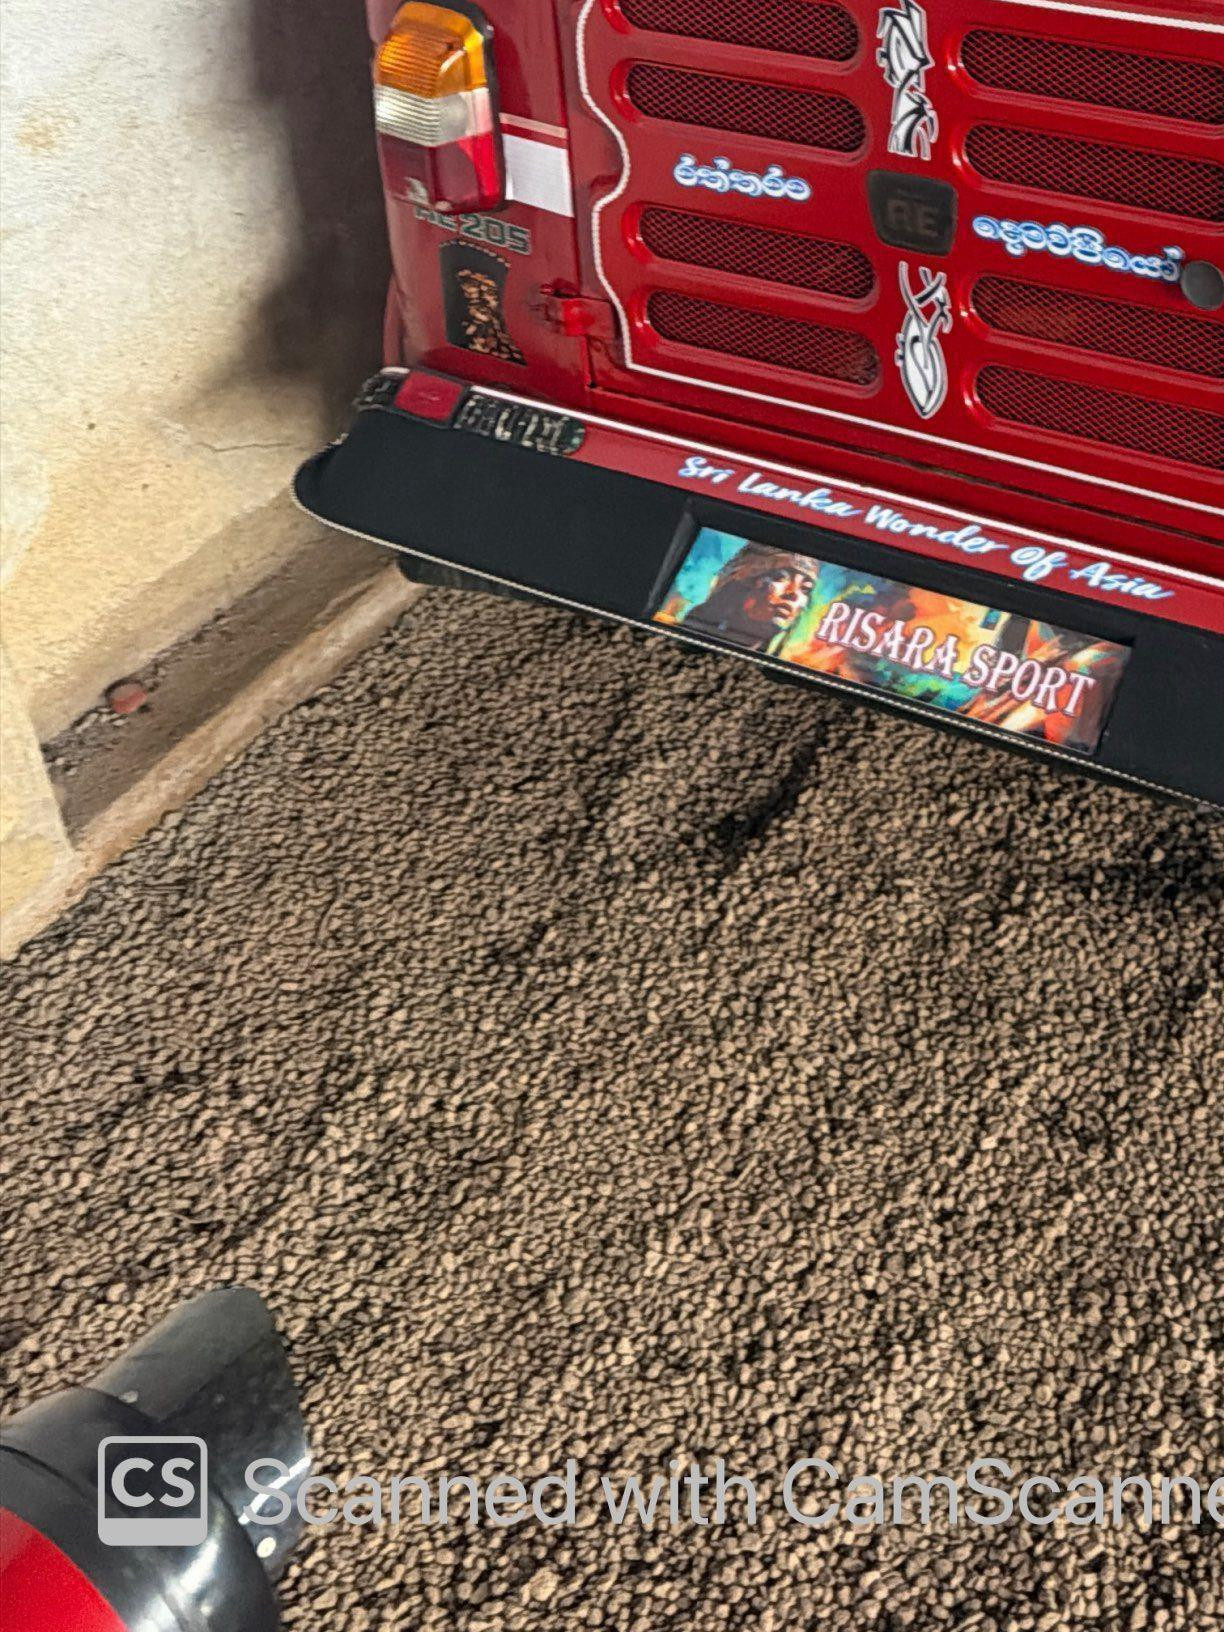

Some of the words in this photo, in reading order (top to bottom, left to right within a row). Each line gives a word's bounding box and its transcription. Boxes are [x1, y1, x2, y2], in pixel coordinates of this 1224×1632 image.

[677, 455, 735, 490] Sri
[738, 470, 863, 520] Lanka
[866, 503, 1008, 556] Wonder
[1010, 546, 1068, 582] Of
[1069, 561, 1176, 602] Asia
[817, 601, 961, 677] RISARA
[966, 642, 1097, 718] SPORT
